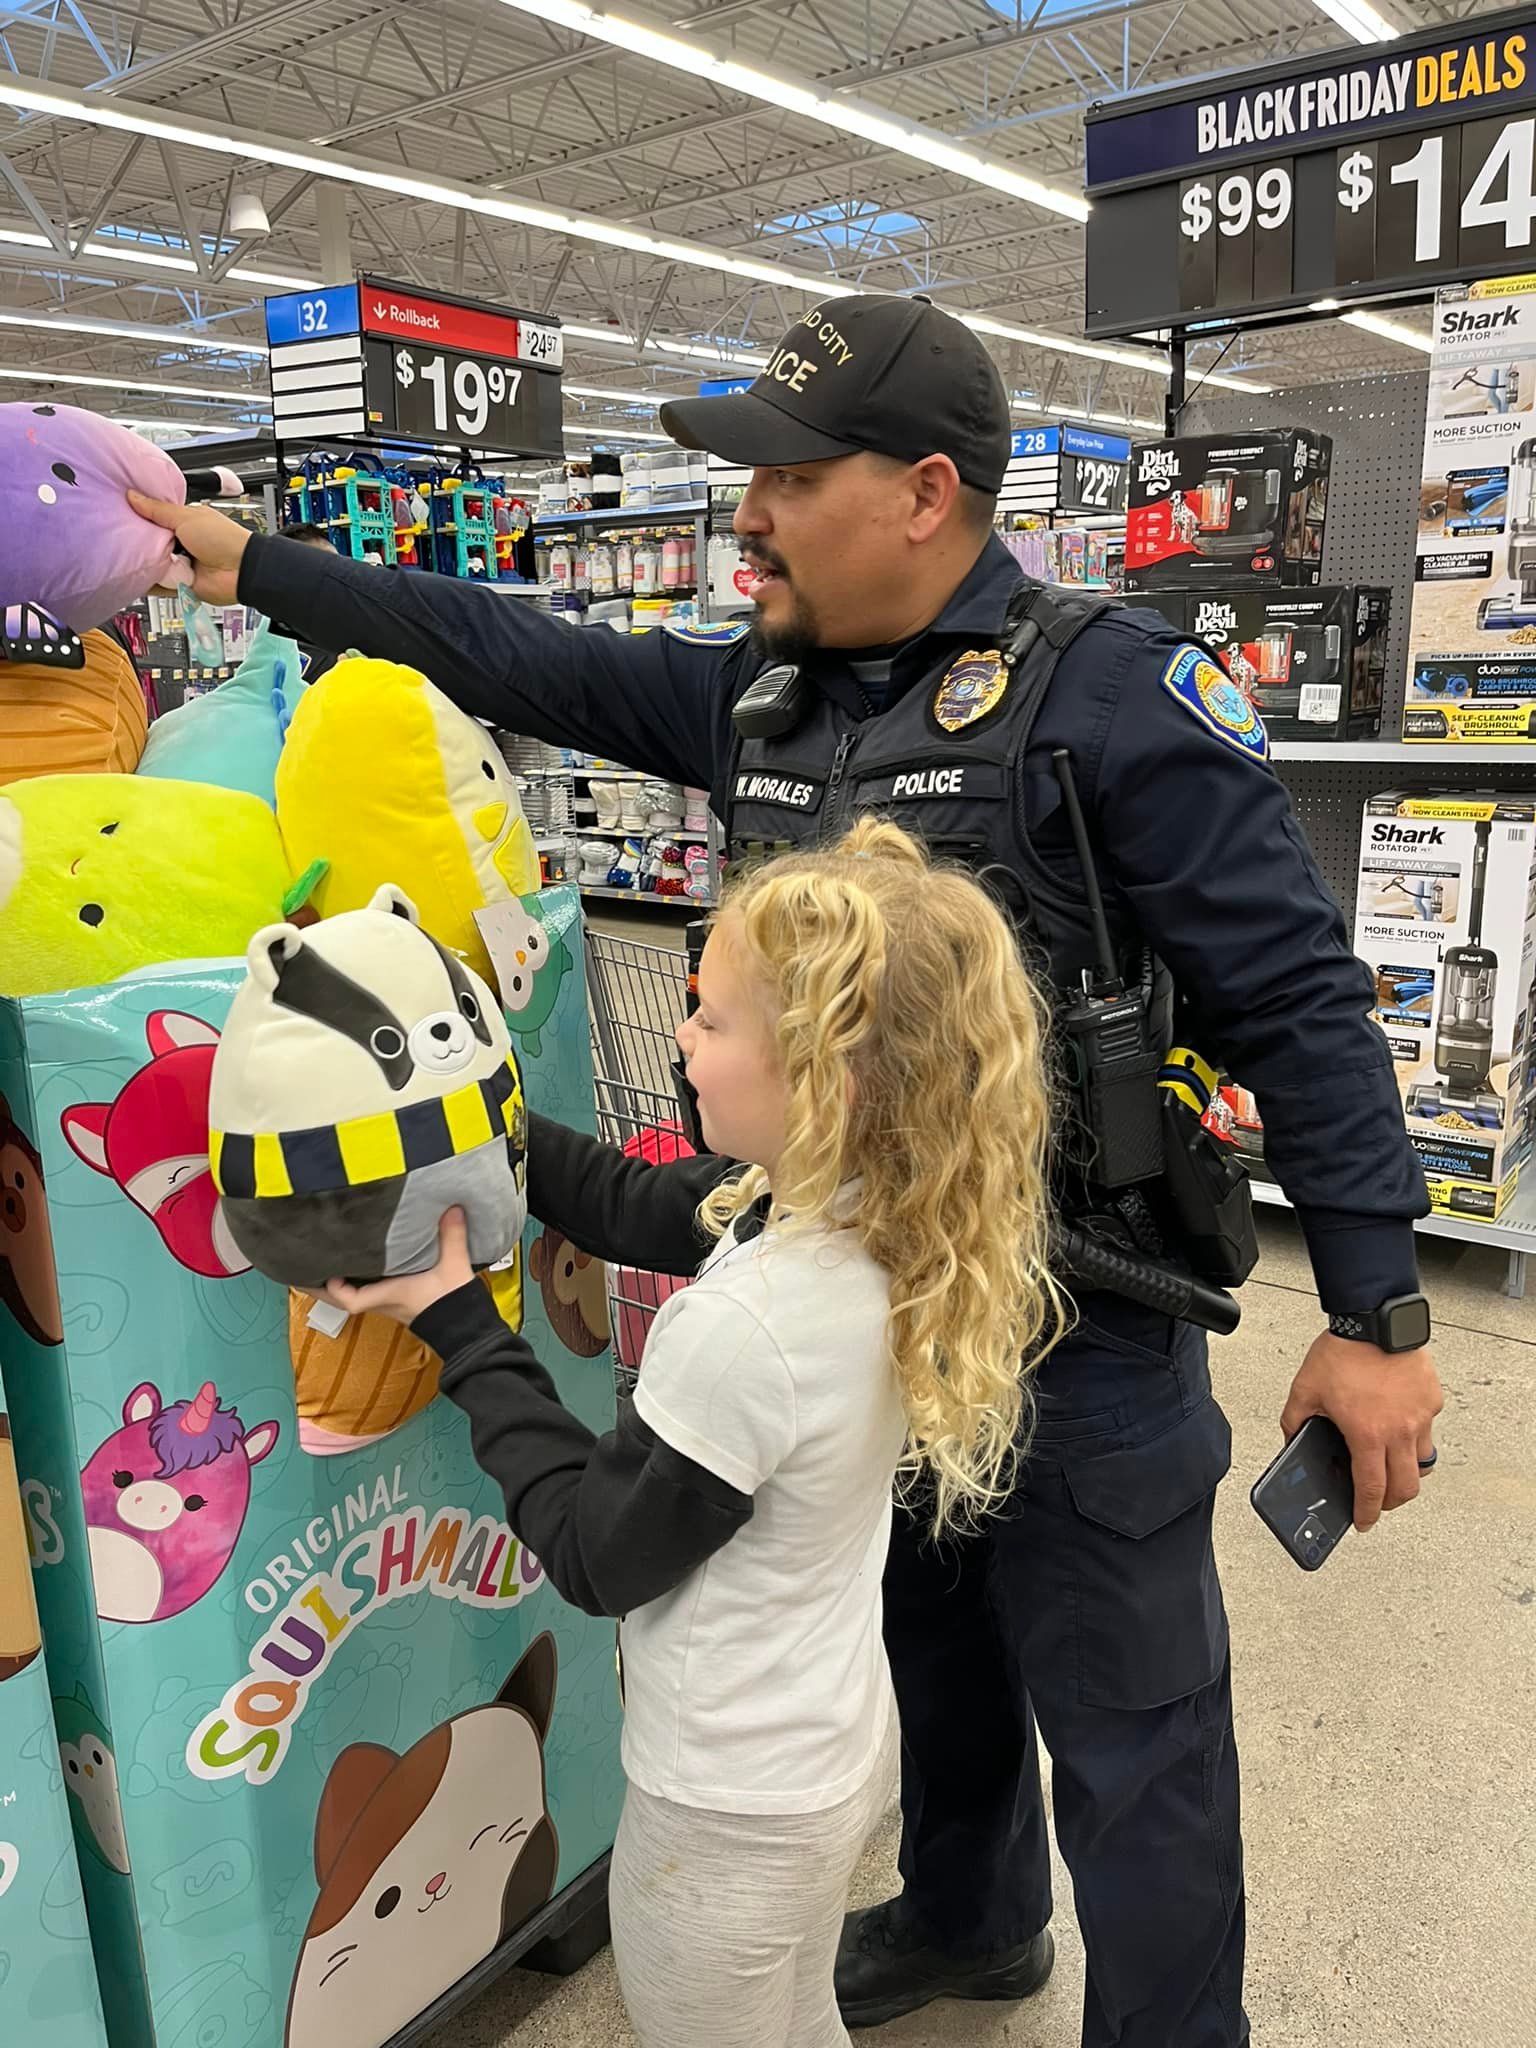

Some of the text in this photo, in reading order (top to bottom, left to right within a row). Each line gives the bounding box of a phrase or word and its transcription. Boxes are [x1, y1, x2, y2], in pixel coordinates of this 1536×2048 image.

[1198, 35, 1527, 152] BLACK FRIDAY DEALS
[1181, 168, 1292, 242] $99
[1485, 286, 1505, 295] NOW
[302, 299, 328, 333] 32
[390, 304, 440, 330] Rollback
[1441, 305, 1521, 333] Shark
[817, 322, 854, 367] CITY
[1440, 332, 1491, 345] ROTATOR
[762, 347, 819, 392] ICE
[1434, 421, 1521, 438] MORE SUCTION
[1025, 433, 1046, 452] 28
[1142, 450, 1174, 469] Dirt
[1138, 462, 1180, 482] Devil
[1199, 602, 1232, 621] Dirt
[1195, 613, 1238, 633] Devil
[1452, 714, 1526, 722] SELF-CLEANING
[747, 776, 814, 806] MORALES
[892, 768, 964, 797] POLICE
[1371, 823, 1446, 845] Shark
[1371, 844, 1417, 853] ROTATOR
[1369, 859, 1427, 870] LIFT-AWAY
[1364, 926, 1394, 936] MORE
[1397, 928, 1445, 940] SUCTION
[1458, 953, 1483, 963] Shark
[1100, 1006, 1138, 1021] MOTOROLA
[1438, 1133, 1459, 1141] EVERY
[244, 1465, 409, 1613] ORIGINAL
[199, 1517, 546, 1773] SQUISHMALLO
